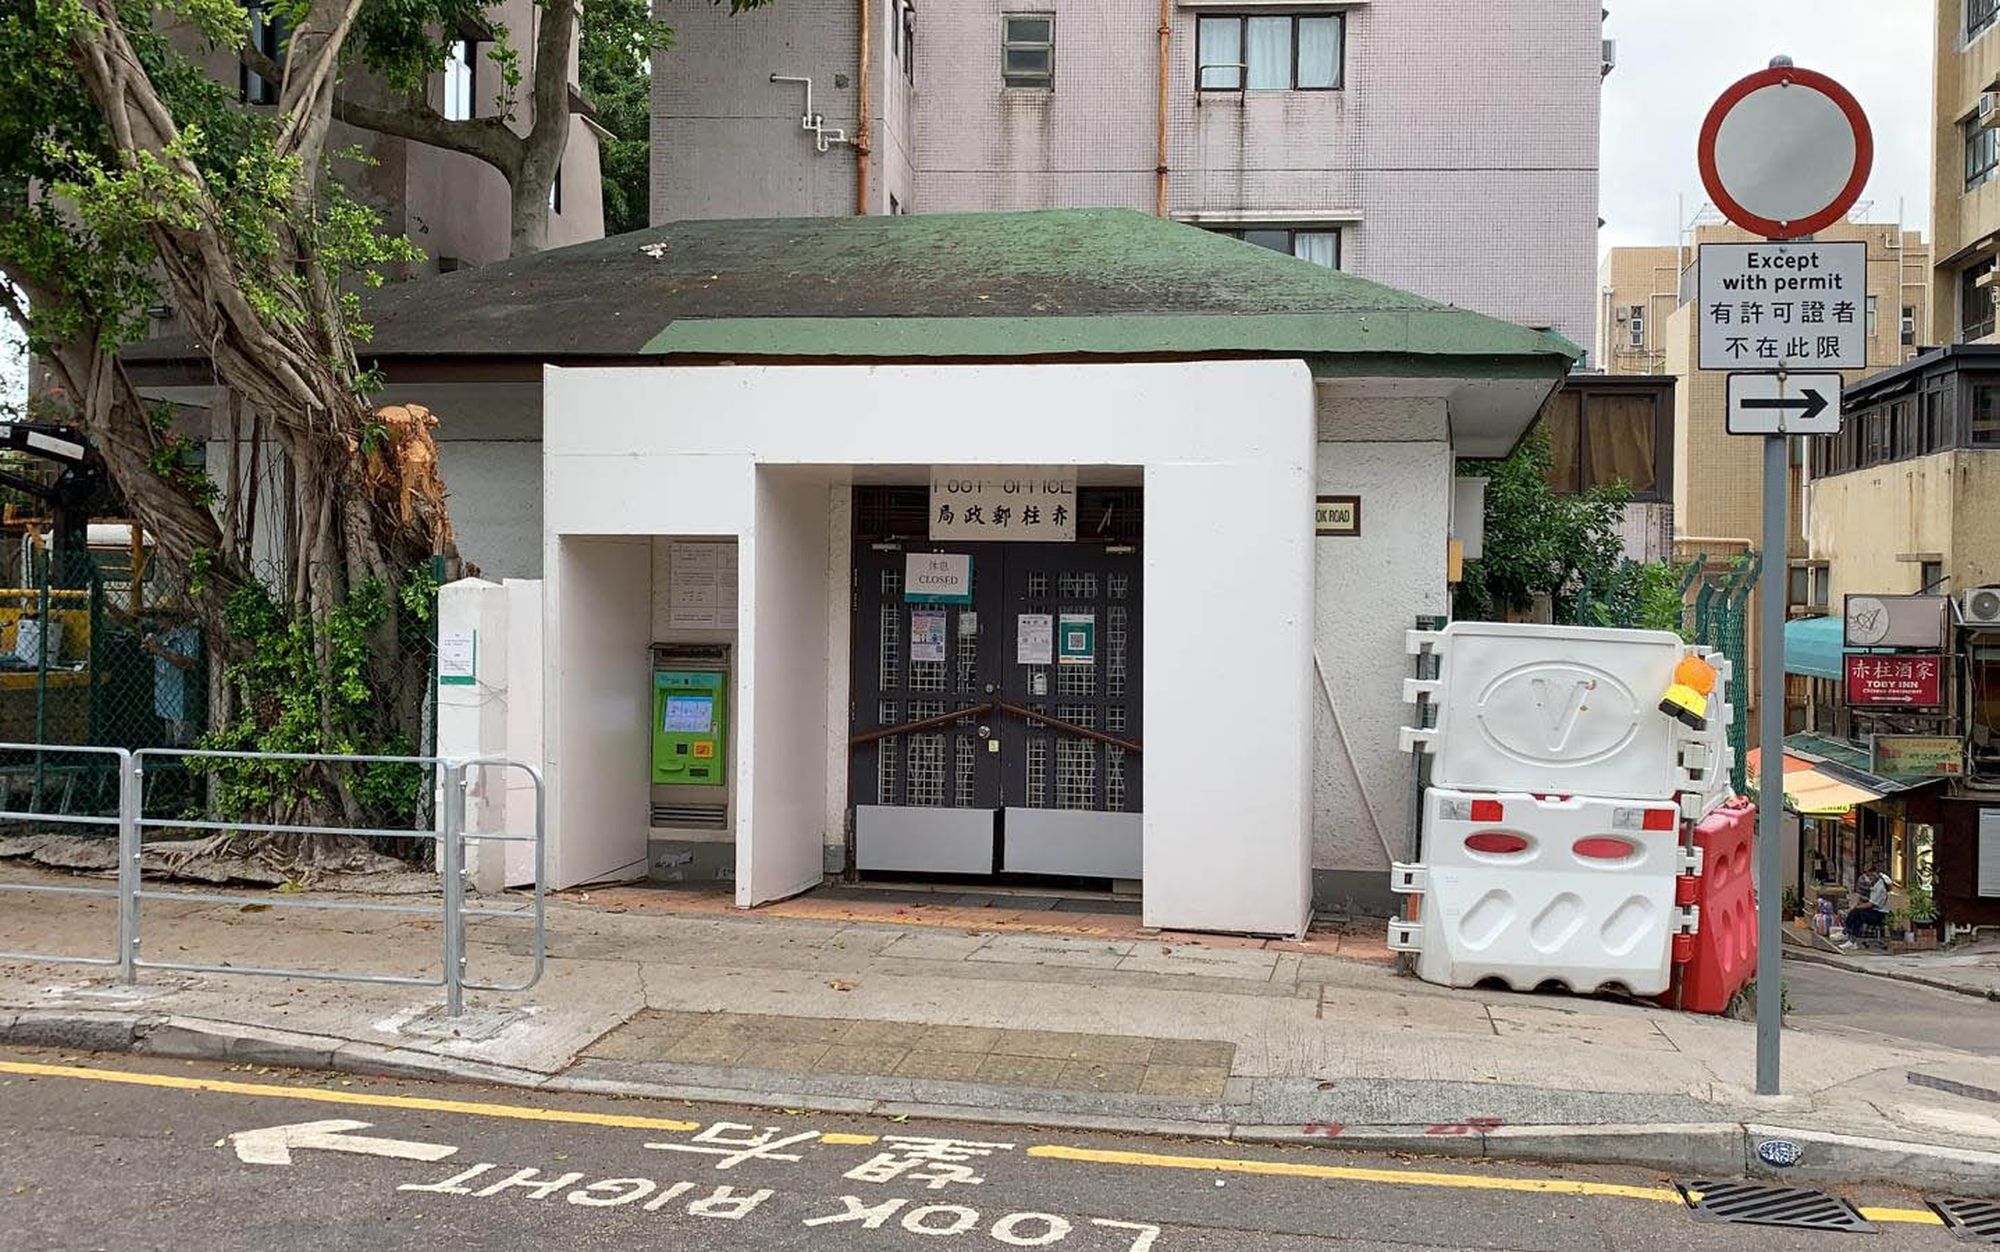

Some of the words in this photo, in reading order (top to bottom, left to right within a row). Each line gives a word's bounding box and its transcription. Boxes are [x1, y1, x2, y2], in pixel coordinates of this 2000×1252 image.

[1747, 252, 1819, 271] Except
[1723, 274, 1767, 290] with
[1775, 273, 1843, 293] permit
[1710, 301, 1856, 325] 有許可證者
[1725, 336, 1841, 360] 不在此限
[1329, 509, 1350, 523] ROAD
[918, 575, 959, 585] CLOSED
[1852, 659, 1934, 680] 赤柱酒家
[1866, 680, 1896, 689] TOBY
[1899, 680, 1919, 689] INN
[396, 1163, 776, 1220] RIGHT
[802, 1195, 1161, 1252] LOOK
